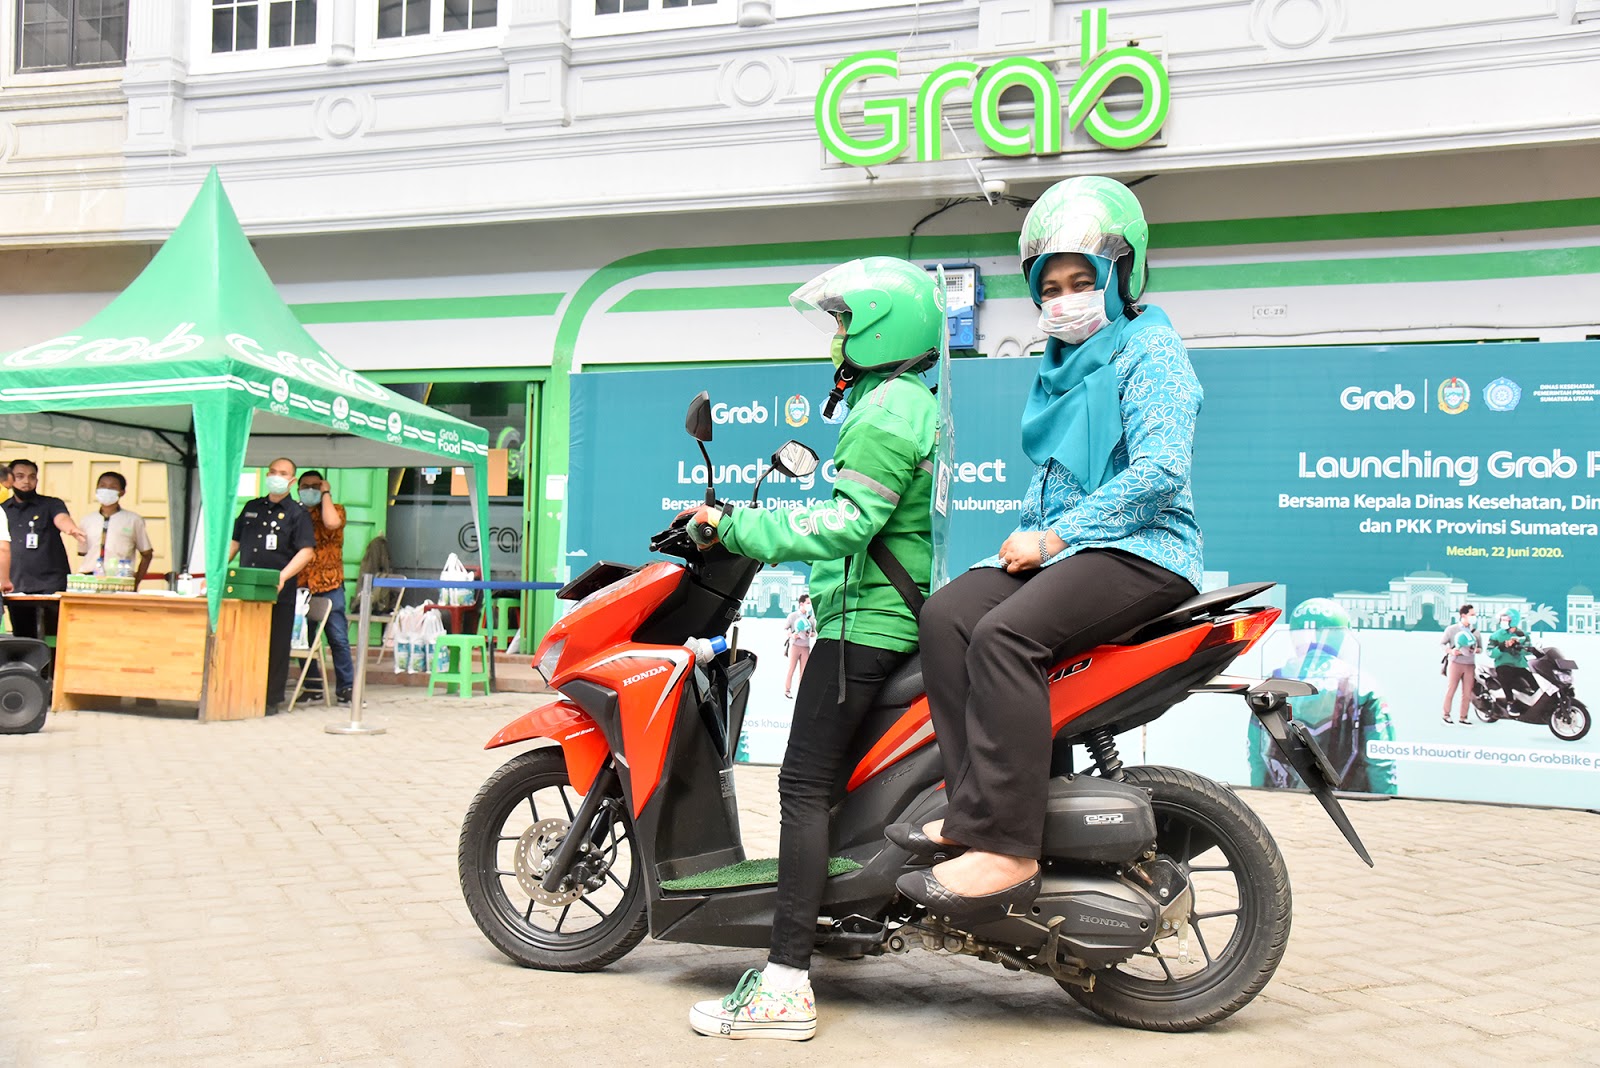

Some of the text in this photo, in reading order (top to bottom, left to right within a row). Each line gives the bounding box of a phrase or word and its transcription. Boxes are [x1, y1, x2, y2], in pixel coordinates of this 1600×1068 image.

[814, 8, 1171, 167] Grab
[3, 322, 205, 366] Grab
[225, 333, 390, 400] Grab
[1340, 384, 1416, 411] Grab
[270, 402, 289, 415] Grab
[711, 400, 769, 424] Grab
[332, 419, 350, 431] Grab
[439, 428, 459, 443] Grab
[387, 433, 403, 445] Grab
[438, 440, 461, 455] Food
[1298, 449, 1479, 486] Launching
[1487, 448, 1578, 479] Grab
[1278, 493, 1350, 508] Bersama
[1353, 493, 1411, 511] Kepala
[1415, 494, 1464, 509] Dinas
[1467, 494, 1567, 512] Kesehatan,
[788, 498, 861, 537] Grab
[1359, 518, 1598, 536] dan PKK Provinsi Sumatera
[1446, 546, 1565, 558] Medan, 22 Juni 2020.
[623, 664, 668, 687] HONDA
[1369, 744, 1410, 756] Bebas
[1412, 745, 1470, 759] khawatir
[1474, 748, 1526, 764] dengan
[1529, 752, 1591, 767] GrabBike
[1079, 914, 1131, 929] HONDA
